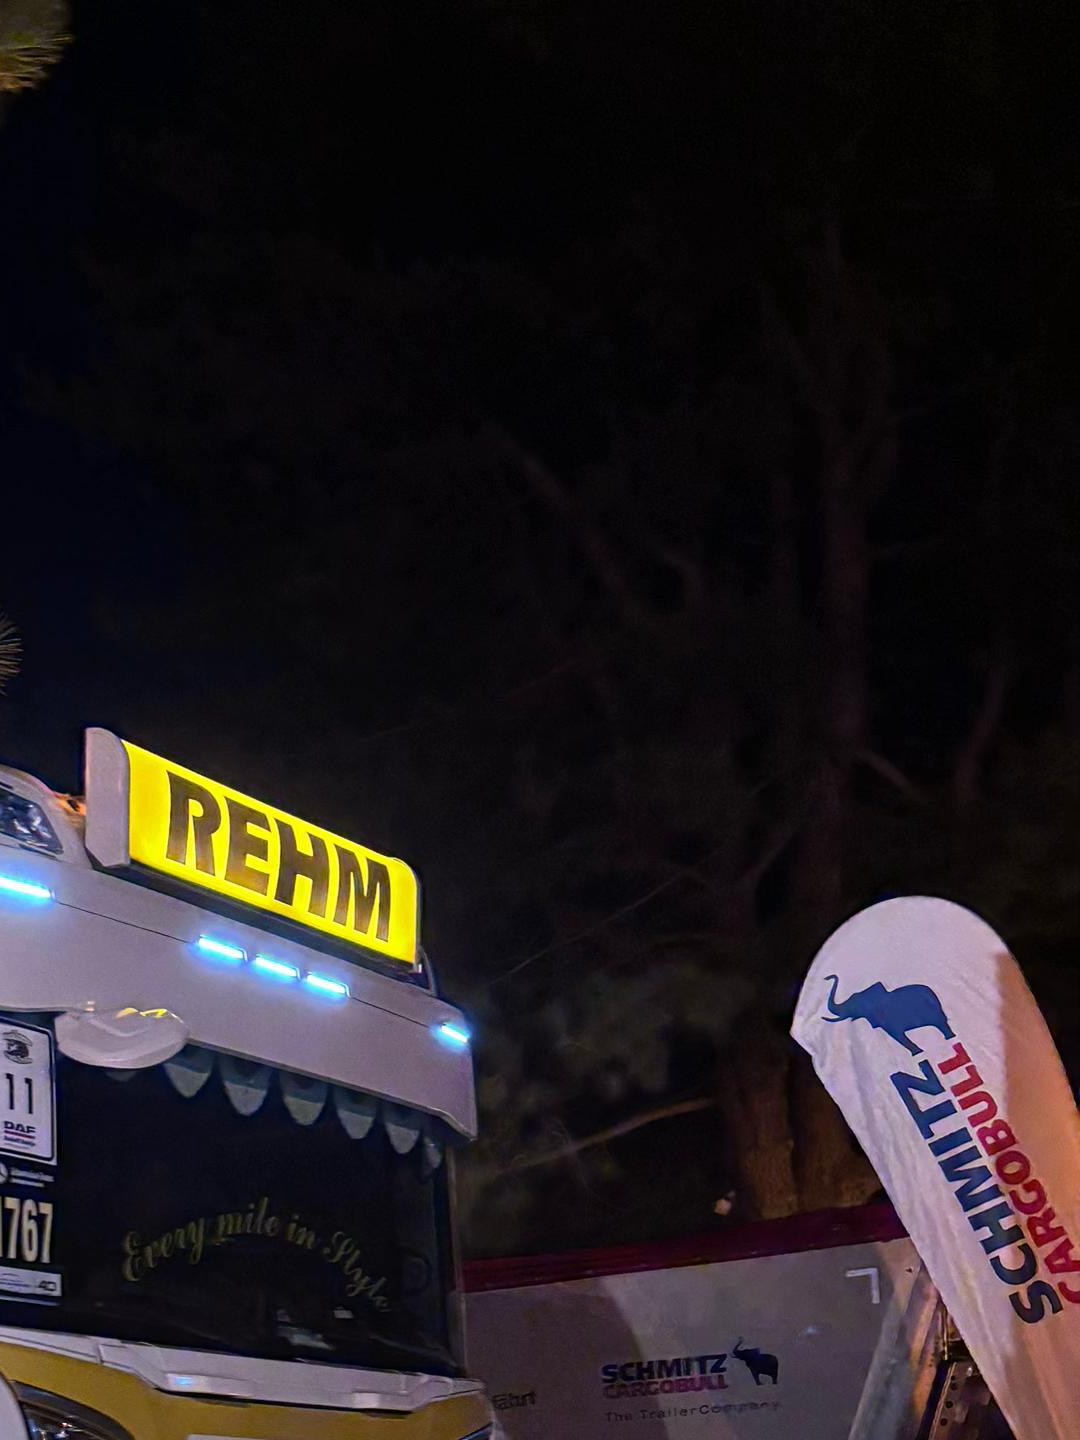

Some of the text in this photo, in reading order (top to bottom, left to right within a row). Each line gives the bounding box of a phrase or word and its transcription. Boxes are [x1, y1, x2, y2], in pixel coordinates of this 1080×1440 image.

[166, 771, 391, 943] REHM
[5, 1072, 33, 1115] 11
[3, 1120, 36, 1133] DAF
[890, 1059, 1063, 1324] SCHMITZ
[937, 1042, 1080, 1304] CARGOBULL
[122, 1217, 205, 1282] Every
[217, 1196, 280, 1237] mile
[286, 1214, 317, 1249] in
[601, 1353, 728, 1384] SCHMITZ
[602, 1374, 729, 1399] CARGOBULL
